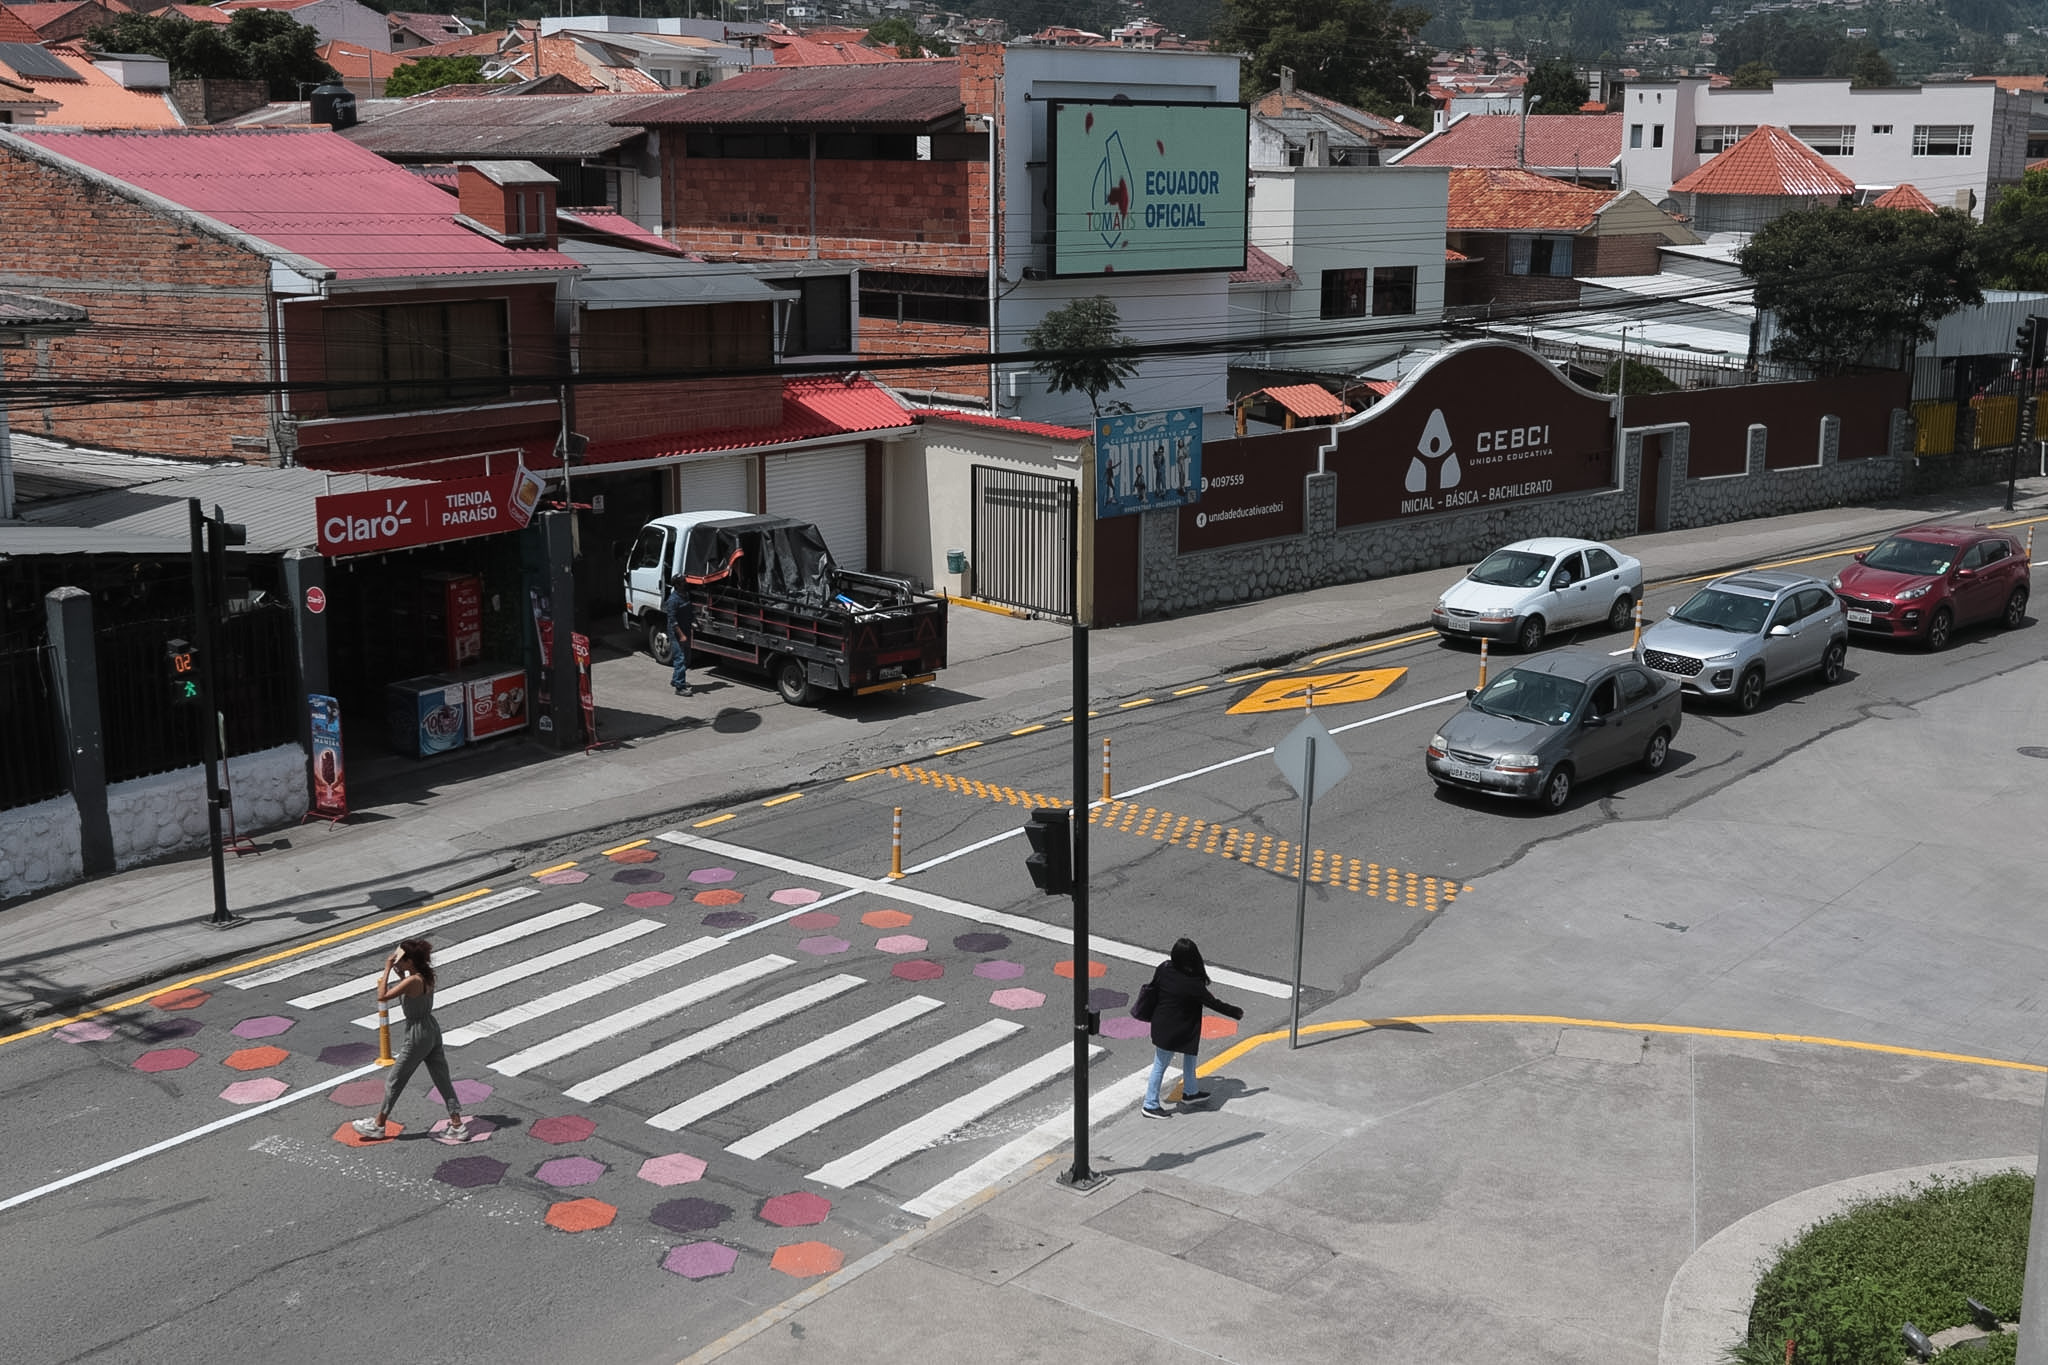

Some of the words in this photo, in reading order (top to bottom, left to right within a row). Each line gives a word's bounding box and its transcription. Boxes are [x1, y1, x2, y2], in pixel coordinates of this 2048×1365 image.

[1145, 170, 1220, 196] ECUADOR
[1145, 202, 1206, 229] OFICIAL
[1476, 425, 1549, 452] CEBCI
[1469, 454, 1503, 466] UNIDAD
[1506, 449, 1553, 462] EDUCATIVA
[1210, 474, 1245, 489] 4097559
[445, 490, 492, 509] TIENDA
[1401, 497, 1435, 514] INICIAL
[1445, 489, 1479, 509] BÁSICA
[1488, 479, 1553, 501] BACHILLERATO
[442, 504, 497, 526] PARAÍSO
[1208, 501, 1284, 523] unidadeducativacebci
[324, 514, 400, 544] Claro
[174, 653, 192, 673] 02
